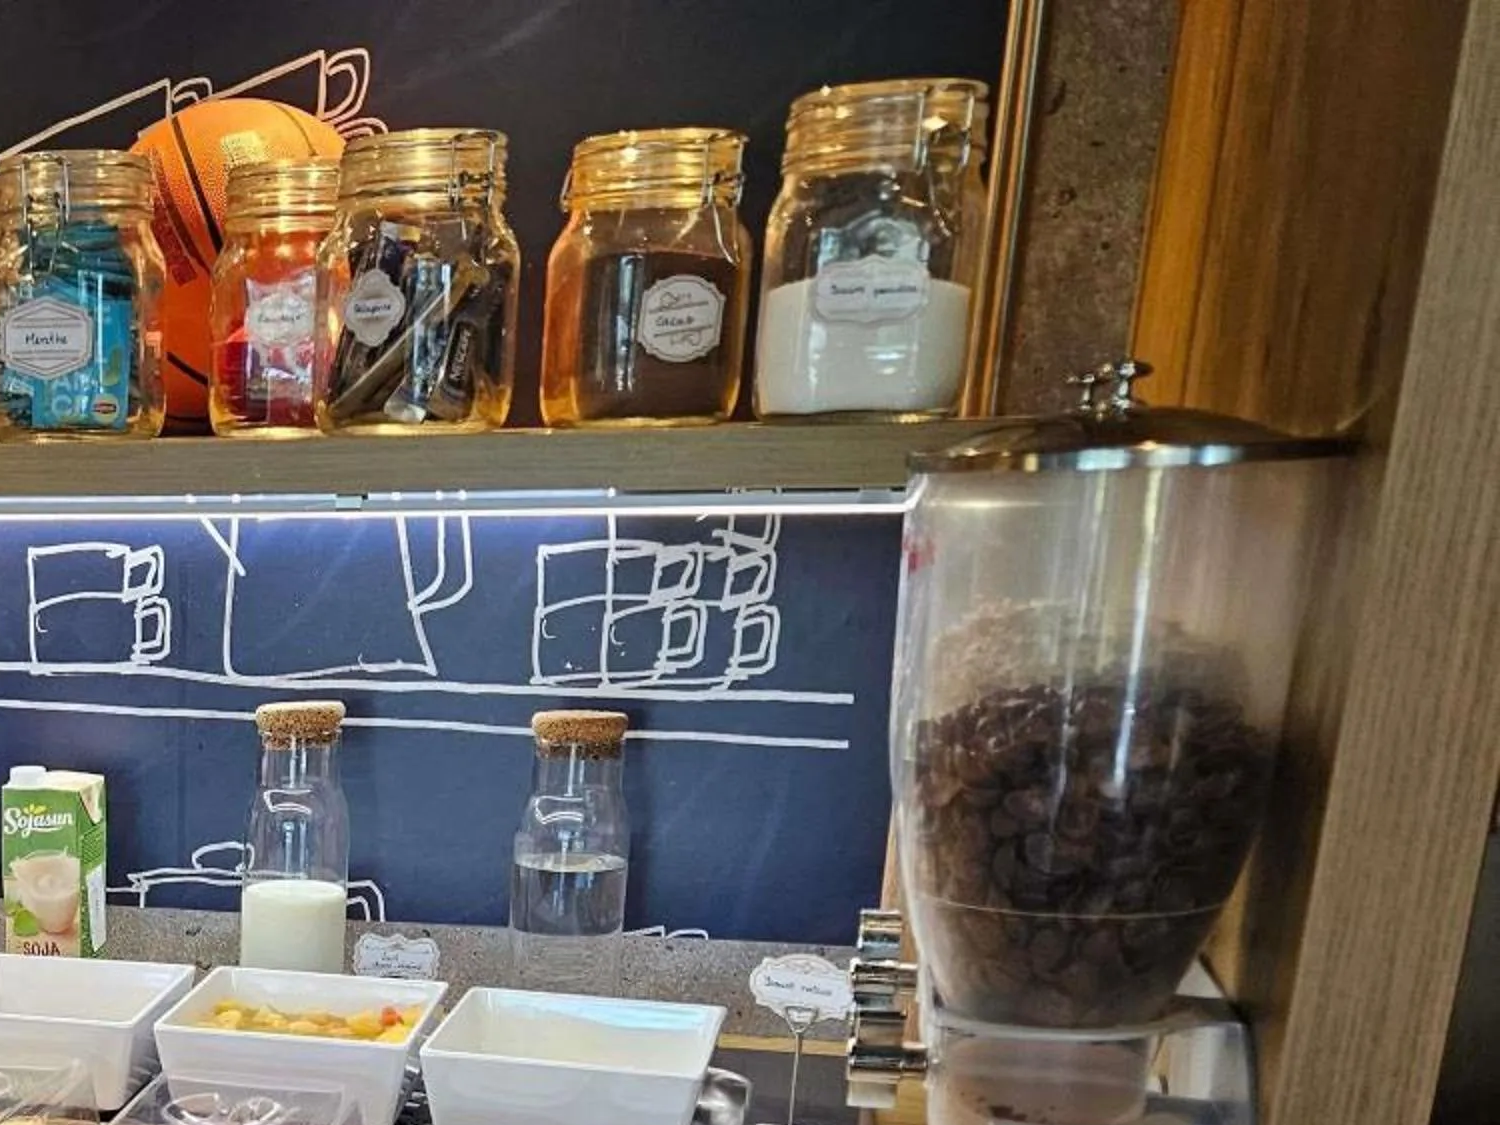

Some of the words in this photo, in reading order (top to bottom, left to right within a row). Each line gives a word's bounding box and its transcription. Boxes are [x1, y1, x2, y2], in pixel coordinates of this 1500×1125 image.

[24, 333, 69, 346] Menthe
[4, 807, 73, 838] Sojasun
[23, 941, 60, 956] SOJA
